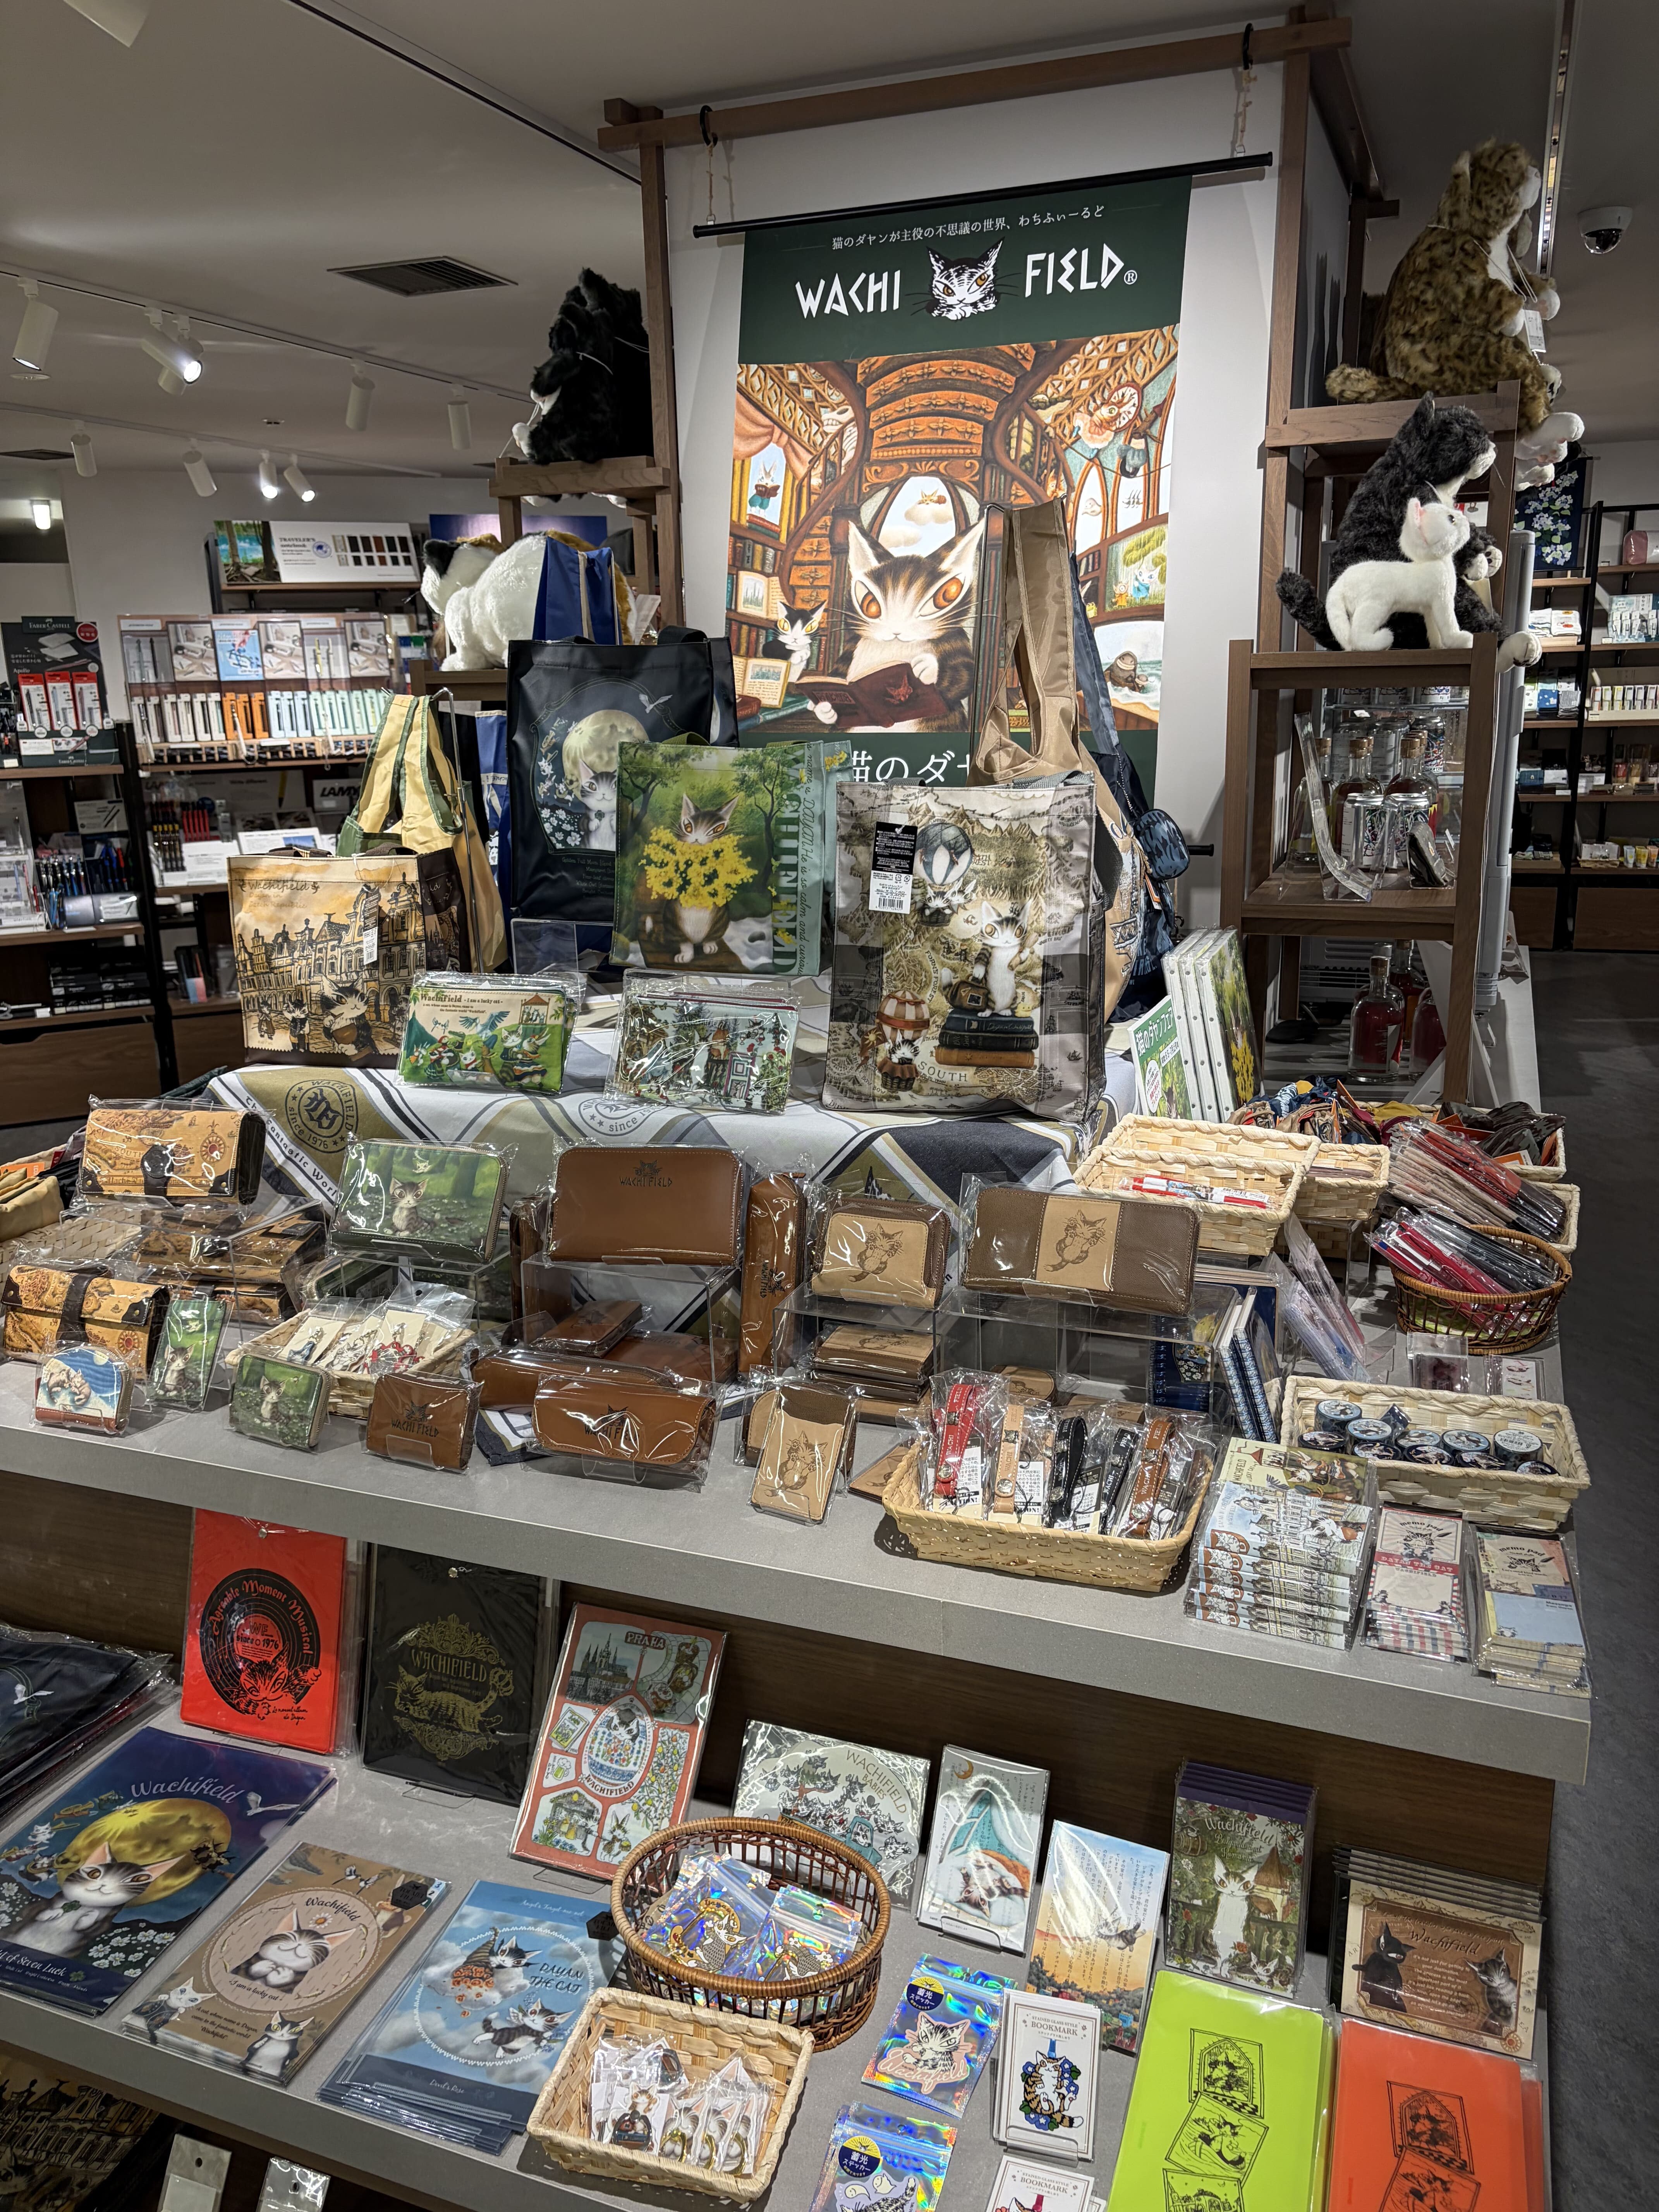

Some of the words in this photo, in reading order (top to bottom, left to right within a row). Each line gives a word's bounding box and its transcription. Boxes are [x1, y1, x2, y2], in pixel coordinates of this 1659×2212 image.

[831, 204, 1104, 250] 猫のダヤンが主役の不思議の世界、わちふぃーるど
[795, 269, 901, 319] WACHI
[852, 750, 969, 782] 猫のダ
[248, 881, 310, 893] Wachifield
[800, 877, 807, 889] so
[799, 892, 812, 922] calm
[799, 924, 809, 942] and
[421, 993, 462, 1002] Wachifield
[918, 1061, 968, 1082] SOUTH
[289, 1106, 304, 1137] since
[308, 1132, 329, 1149] 1976
[609, 1117, 638, 1132] since
[312, 1168, 337, 1197] Worl
[620, 1176, 646, 1187] WACHI
[649, 1176, 673, 1188] FIELD
[953, 1386, 963, 1403] FIELD
[391, 1419, 416, 1434] WACHI
[417, 1425, 440, 1438] FIELD
[1152, 1423, 1163, 1440] FIELD
[946, 1434, 954, 1456] WACHI
[1119, 1432, 1130, 1448] FIELD
[1232, 1459, 1247, 1482] WACHIFIELD
[1141, 1471, 1152, 1495] WACHI
[1426, 1522, 1444, 1532] pad
[1528, 1548, 1545, 1557] pad
[243, 1580, 287, 1603] Moment
[289, 1599, 314, 1655] Musical
[236, 1635, 254, 1644] since
[262, 1638, 279, 1649] 1976
[626, 1632, 666, 1649] PRAHA
[411, 1649, 487, 1683] WACHIFIELD
[131, 1777, 245, 1805] Wachifield
[584, 1776, 634, 1796] WACHIFIELD
[846, 1750, 907, 1814] WACHIFIELD
[862, 1774, 887, 1800] BABIES
[1205, 1818, 1274, 1846] Wachifield
[1221, 1847, 1252, 1862] Romania
[306, 1897, 362, 1922] Wachifield
[1410, 1928, 1482, 1955] Wachifield
[6, 1953, 19, 1964] of
[17, 1956, 43, 1970] Seven
[42, 1963, 67, 1977] Luck
[539, 1962, 584, 1980] DAYAN
[252, 1987, 268, 1999] lucky
[530, 1975, 555, 1988] THE
[555, 1980, 582, 1995] CAT
[917, 1987, 933, 1999] 蓄光
[909, 1993, 935, 2006] ステッカー
[1031, 2021, 1078, 2036] BOOKMARK
[879, 2051, 968, 2088] Wachifield
[450, 2085, 465, 2094] Rose
[843, 2158, 871, 2171] ステッカー
[850, 2151, 868, 2165] 蓄光
[1020, 2177, 1068, 2194] BOOKMARK
